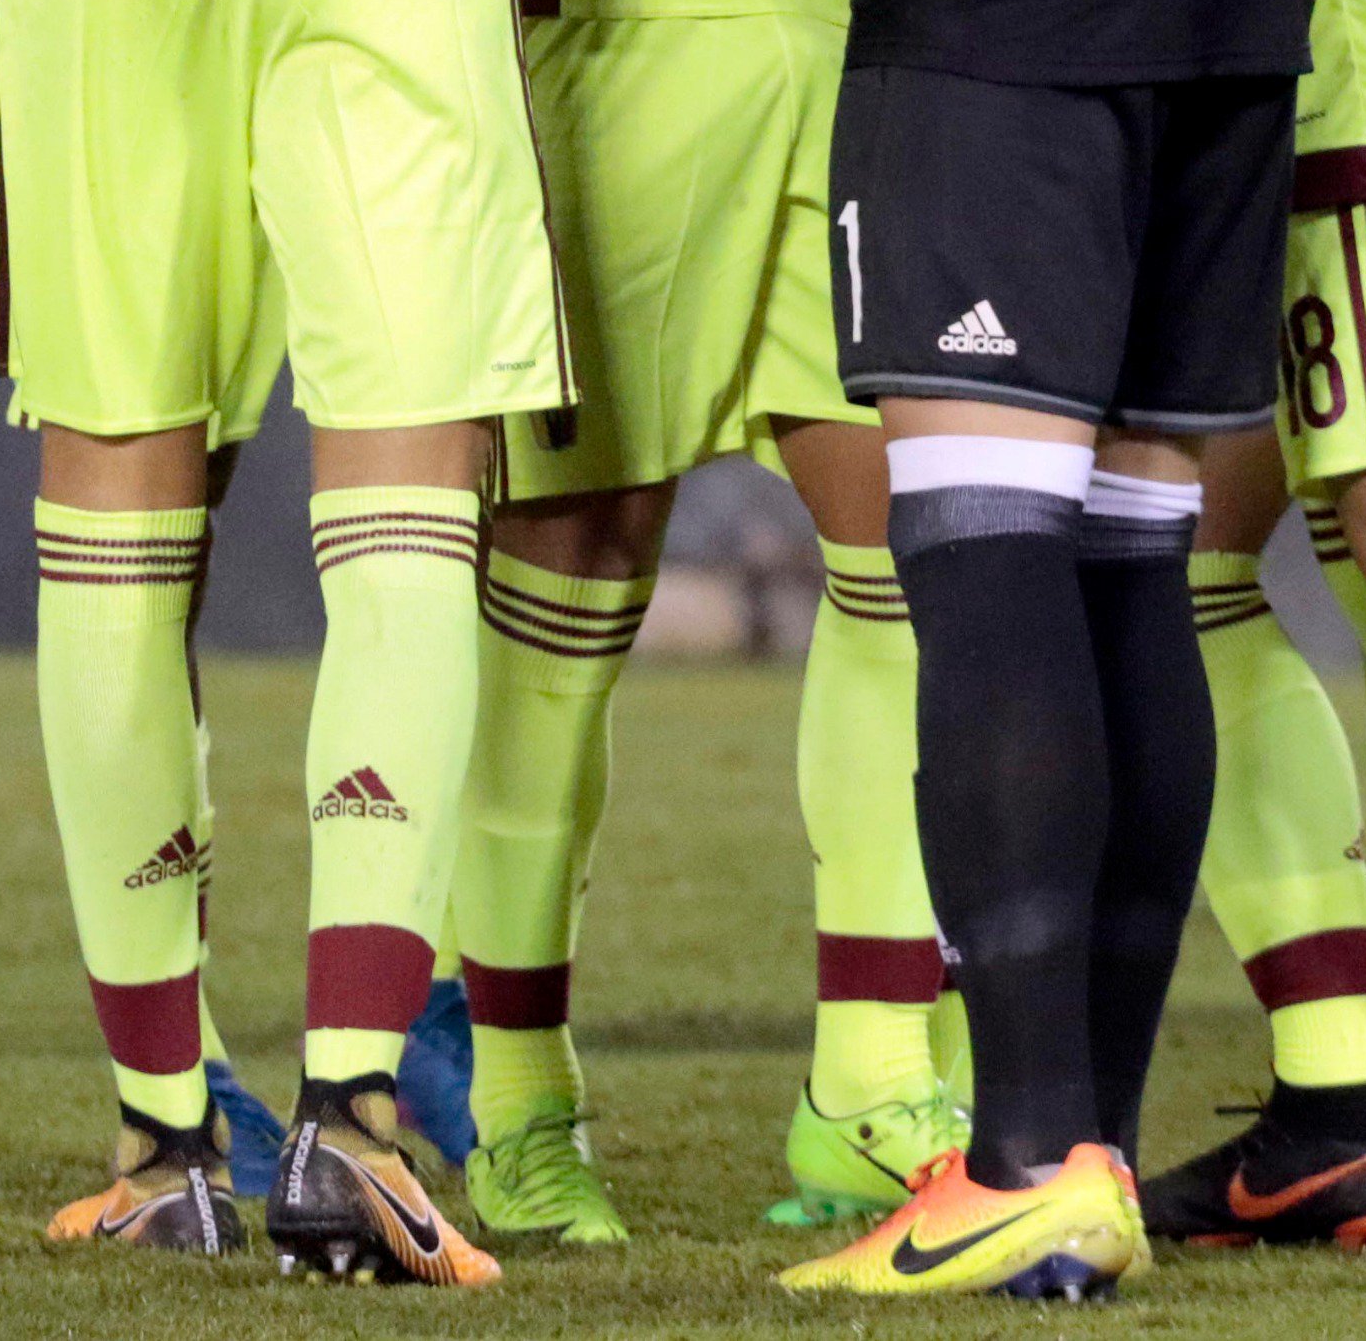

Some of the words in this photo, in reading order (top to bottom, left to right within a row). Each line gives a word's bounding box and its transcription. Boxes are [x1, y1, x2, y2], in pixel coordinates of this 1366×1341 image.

[837, 199, 863, 344] 1
[937, 334, 1018, 356] adidas
[1280, 293, 1347, 438] 18
[312, 797, 409, 823] adidas
